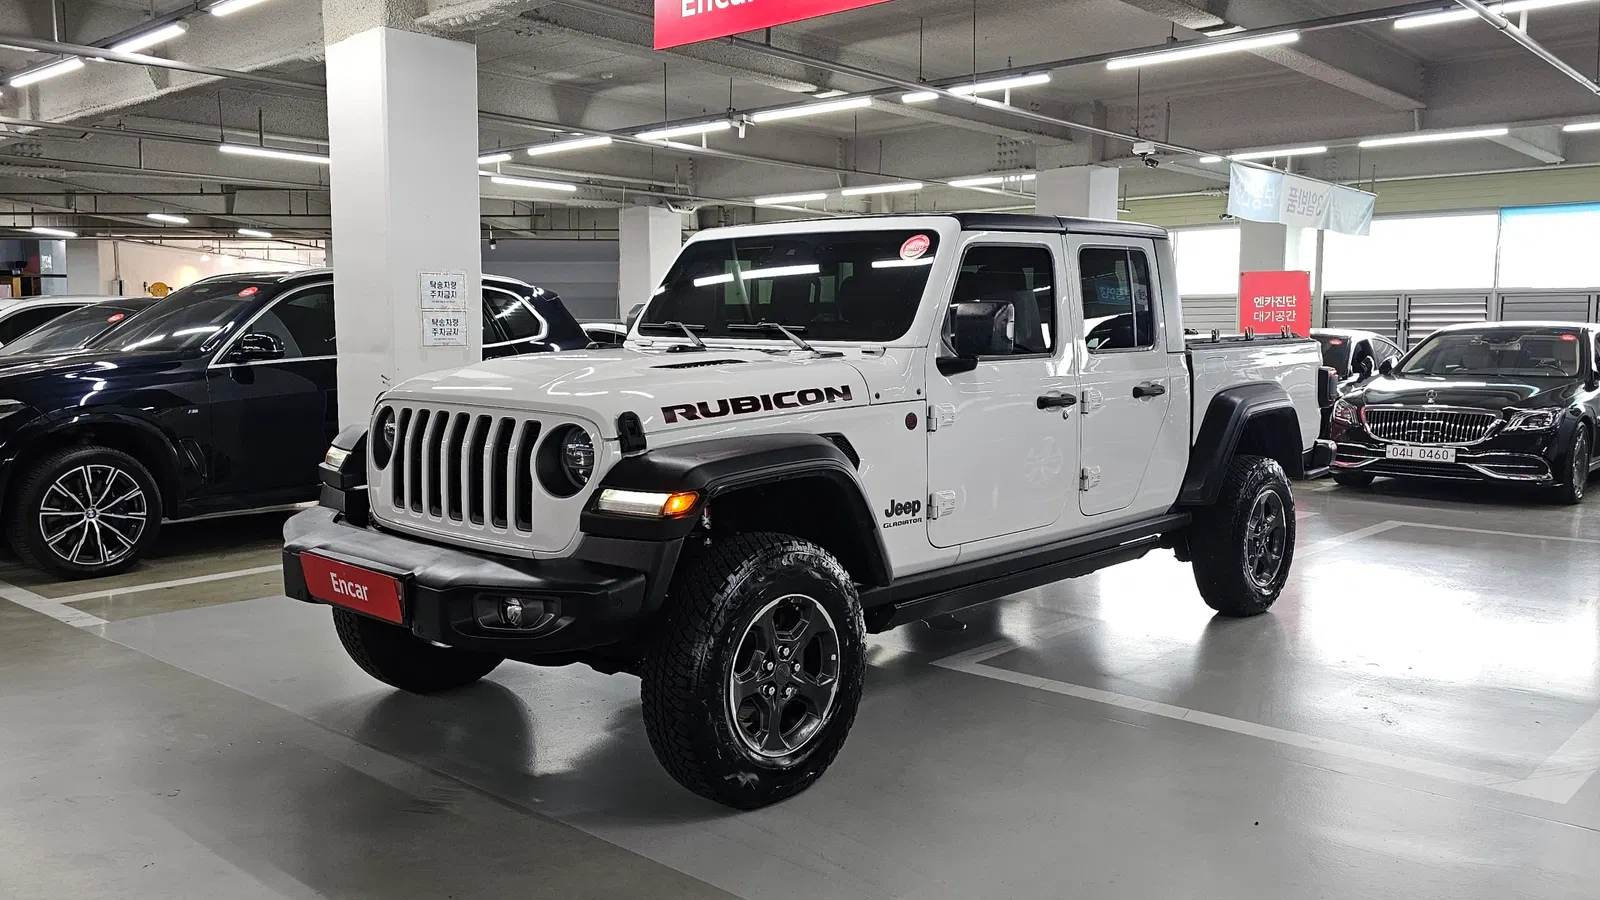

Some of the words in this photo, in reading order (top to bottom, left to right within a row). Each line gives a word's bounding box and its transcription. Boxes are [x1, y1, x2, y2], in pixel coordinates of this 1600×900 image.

[429, 280, 457, 290] 탁송차량
[430, 290, 457, 300] 주차금지
[1253, 295, 1297, 308] 엔카진단
[1253, 310, 1297, 323] 대기공간
[431, 318, 459, 328] 탁송차량
[432, 328, 459, 337] 주차금지
[661, 384, 853, 424] RUBICON
[1419, 449, 1449, 460] 0460
[884, 499, 921, 518] Jeep
[883, 517, 922, 529] GLADIATOR
[329, 571, 368, 602] Encar
